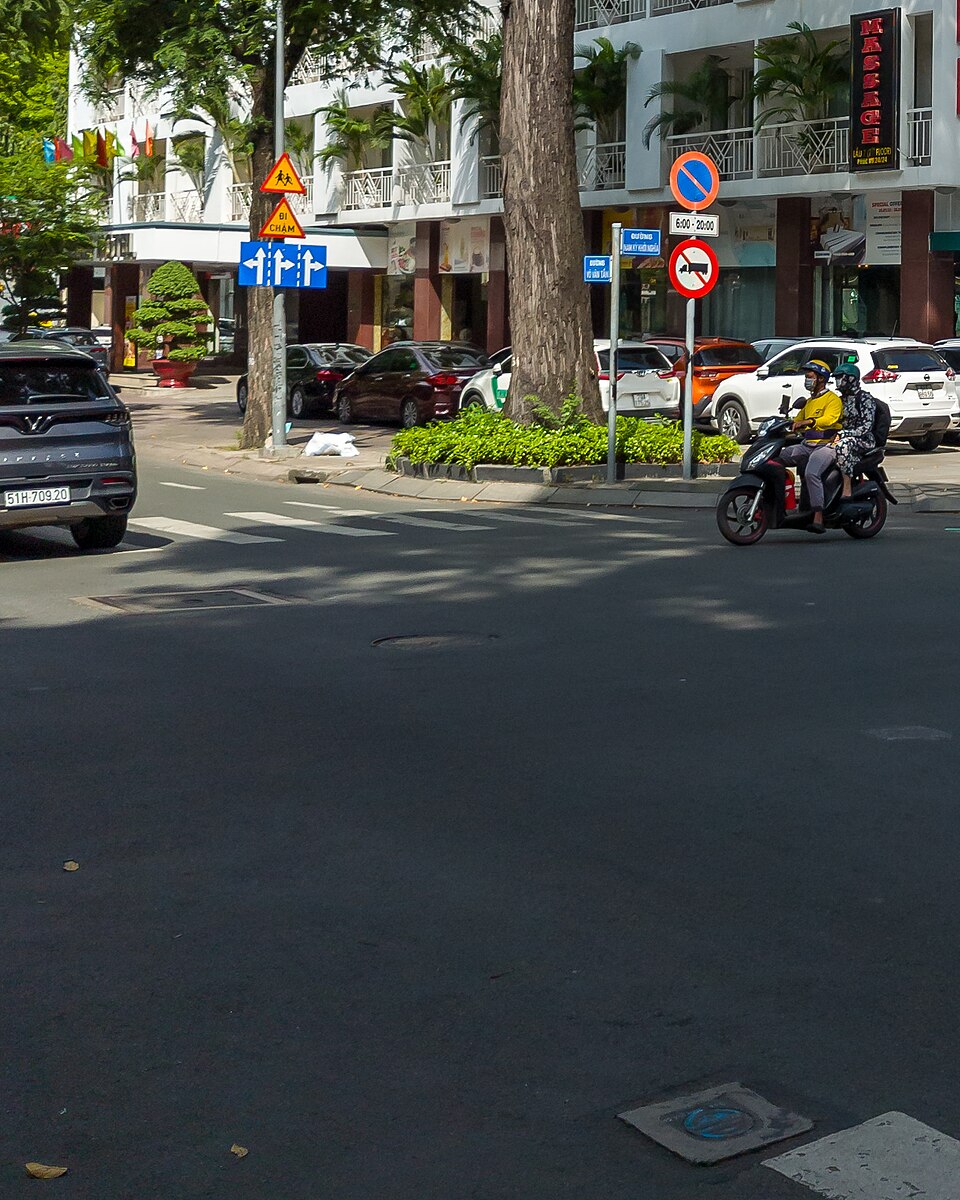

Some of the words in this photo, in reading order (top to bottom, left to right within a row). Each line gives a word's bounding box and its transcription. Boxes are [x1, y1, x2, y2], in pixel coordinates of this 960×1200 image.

[860, 17, 884, 145] MASSAGE
[279, 212, 288, 221] ĐI
[269, 222, 295, 235] CHẬM
[675, 218, 691, 229] 6:00
[696, 219, 715, 231] 20:00
